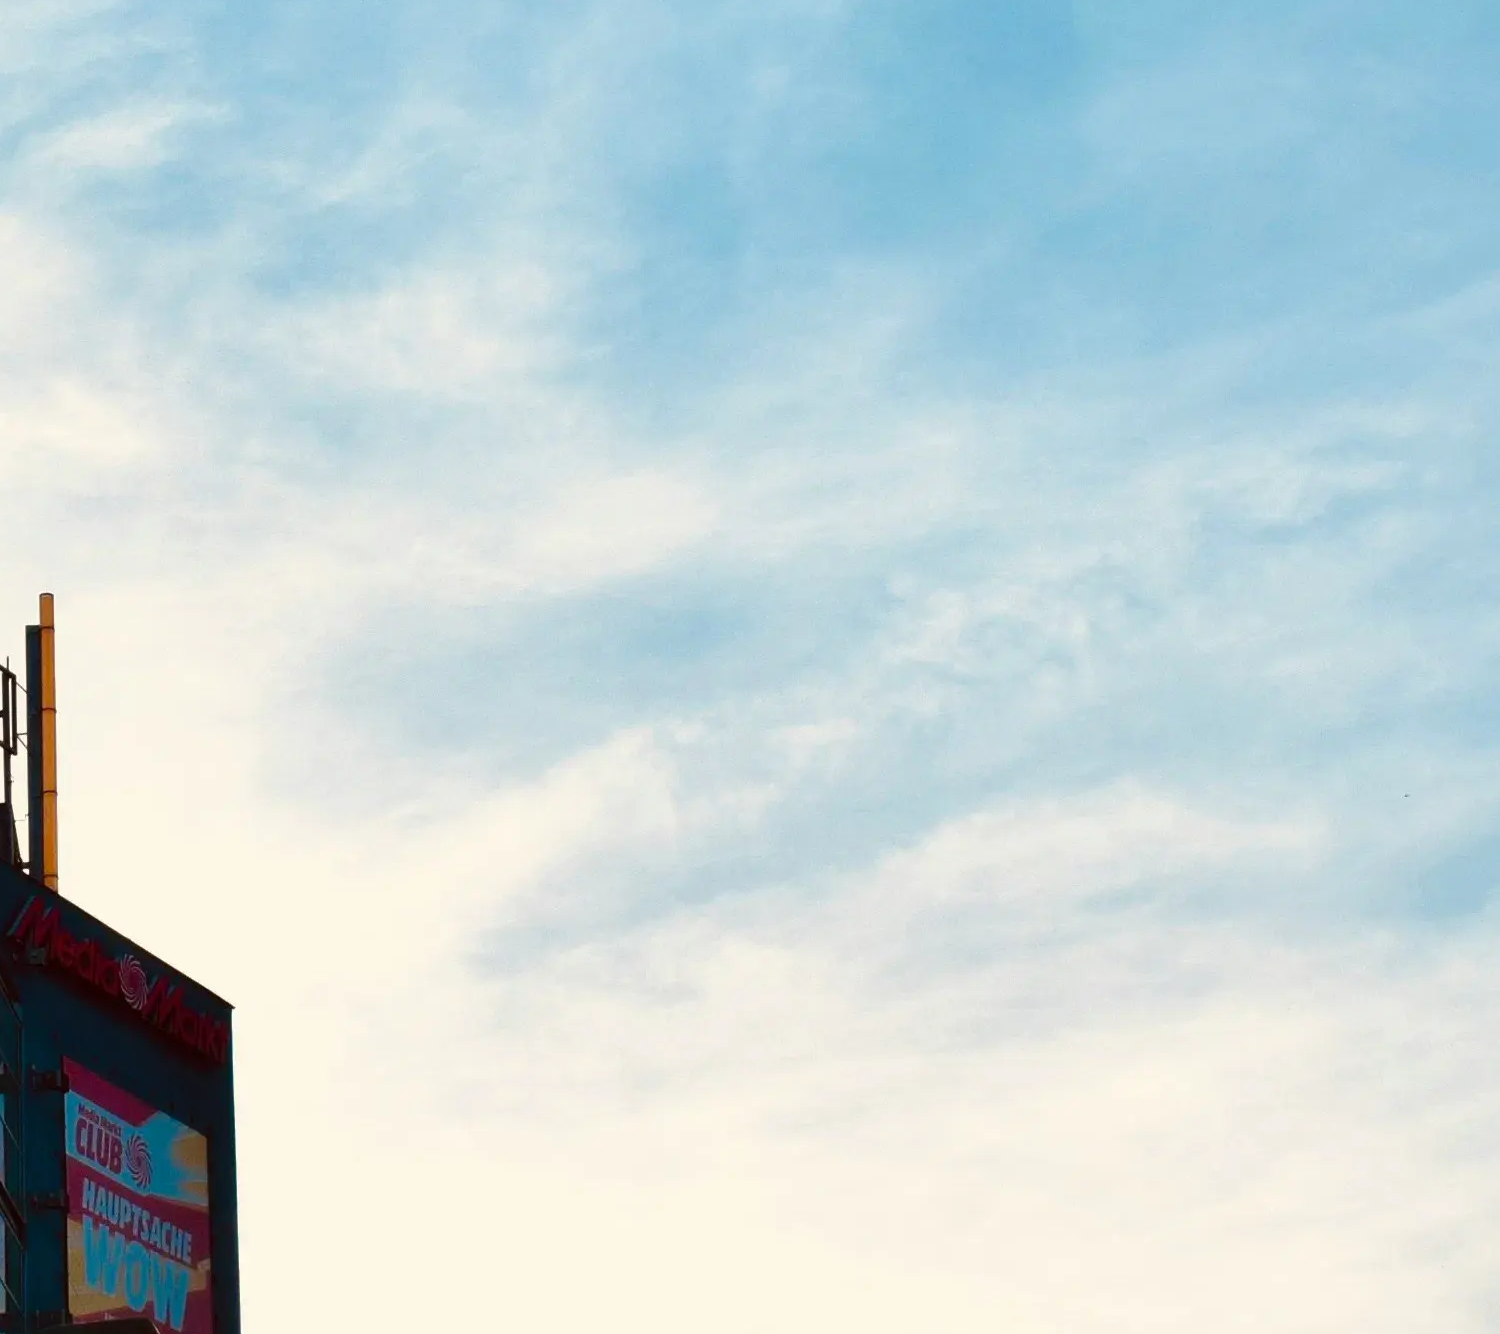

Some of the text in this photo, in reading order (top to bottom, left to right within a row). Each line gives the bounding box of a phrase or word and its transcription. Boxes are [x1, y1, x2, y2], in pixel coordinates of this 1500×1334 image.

[74, 1117, 123, 1174] CLUB
[81, 1177, 193, 1265] HAUPTSACHE
[81, 1213, 190, 1332] WOW
